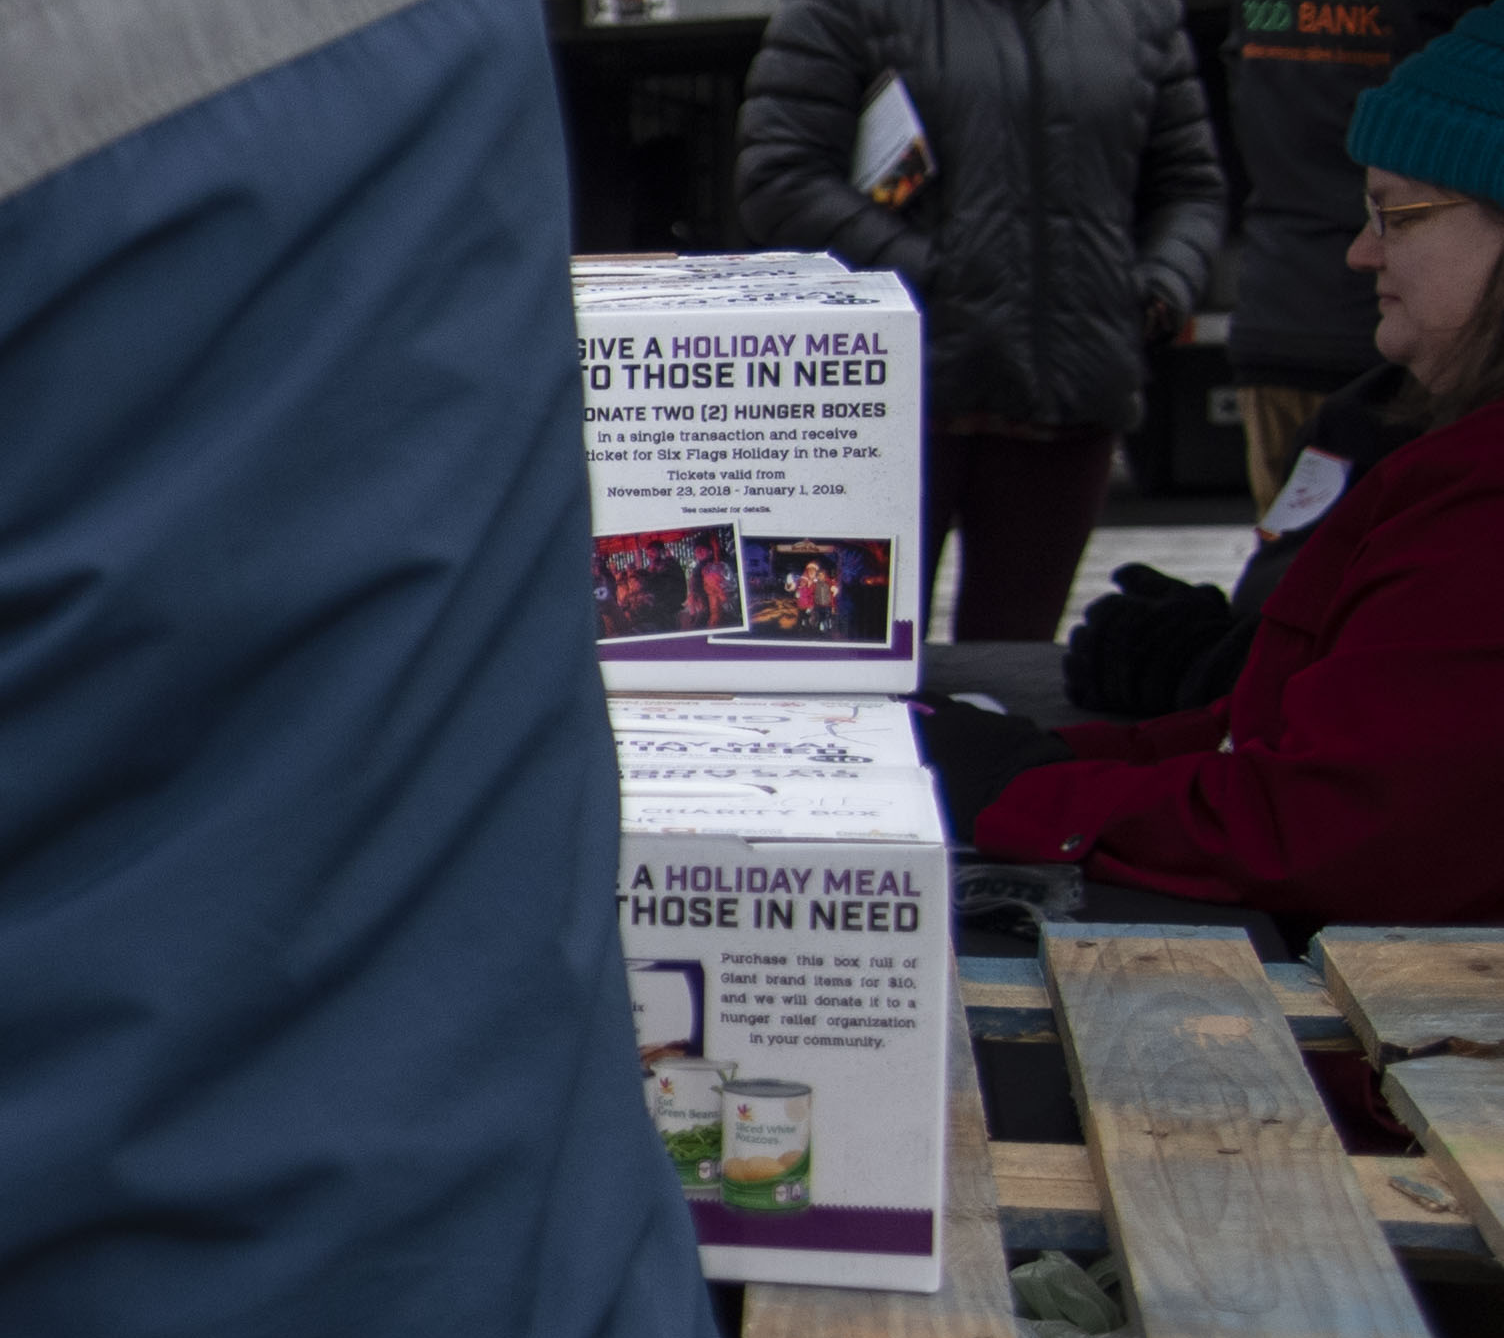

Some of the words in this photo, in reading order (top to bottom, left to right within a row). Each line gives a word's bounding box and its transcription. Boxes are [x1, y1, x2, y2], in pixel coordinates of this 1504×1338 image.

[577, 337, 634, 360] GIVE
[643, 336, 663, 359] A
[672, 334, 796, 359] HOLIDAY
[805, 332, 888, 356] MEAL
[582, 364, 611, 390] O
[621, 362, 735, 390] THOSE
[747, 361, 780, 388] IN
[794, 359, 886, 387] NEED
[584, 406, 646, 422] ONATE
[651, 405, 694, 421] TWO
[734, 404, 815, 420] HUNGER
[822, 402, 886, 418] BOXES
[598, 431, 611, 442] in
[617, 432, 625, 442] a
[630, 430, 675, 444] single
[680, 429, 765, 442] transaction
[769, 429, 797, 440] and
[802, 427, 857, 440] receive
[633, 449, 652, 460] for
[657, 449, 680, 460] Six
[686, 448, 727, 462] Flags
[732, 447, 789, 461] Holiday
[794, 447, 808, 459] in
[813, 447, 837, 458] the
[842, 446, 881, 458] Park.
[667, 470, 715, 481] Tickets
[720, 469, 752, 480] valid
[756, 469, 785, 480] from
[607, 487, 672, 497] November
[699, 486, 731, 497] 2018
[743, 485, 795, 497] January
[812, 484, 847, 495] 2019.
[631, 864, 654, 890] A
[666, 865, 812, 894] HOLIDAY
[823, 868, 921, 897] MEAL
[753, 899, 793, 930] IN
[809, 900, 918, 933] NEED
[721, 952, 787, 965] Purchase
[796, 955, 824, 967] this
[834, 956, 860, 968] box
[870, 957, 893, 968] full
[902, 957, 917, 969] of
[720, 972, 757, 984] Giant
[765, 973, 806, 986] brand
[814, 975, 852, 987] items
[860, 976, 880, 988] for
[721, 993, 746, 1004] and
[754, 995, 774, 1004] we
[781, 994, 807, 1006] will
[814, 995, 862, 1007] donate
[870, 997, 878, 1007] it
[886, 997, 900, 1008] to
[908, 999, 916, 1008] a
[720, 1012, 770, 1026] hunger
[780, 1014, 817, 1026] relief
[826, 1015, 916, 1029] organization
[750, 1033, 763, 1044] in
[767, 1035, 799, 1047] your
[803, 1035, 886, 1050] community.
